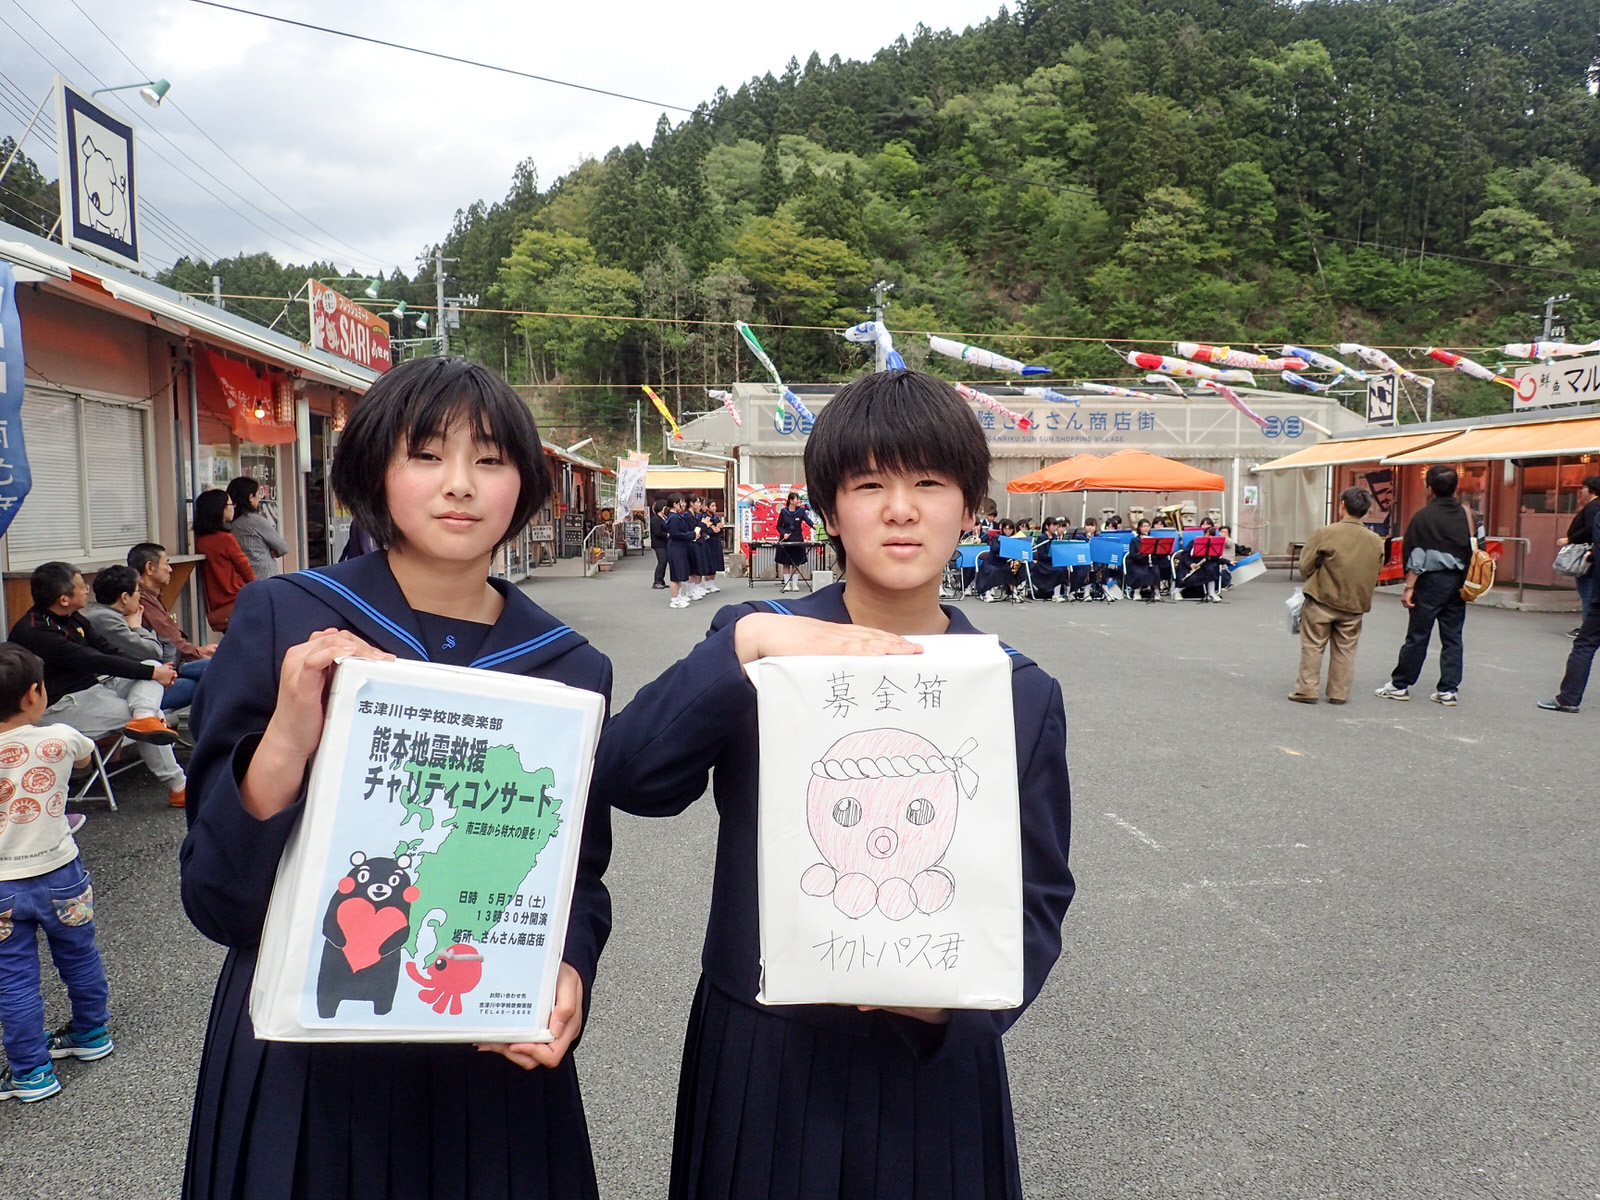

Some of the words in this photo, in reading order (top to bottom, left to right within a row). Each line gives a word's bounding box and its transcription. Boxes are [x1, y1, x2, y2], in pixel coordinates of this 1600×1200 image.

[340, 314, 370, 365] SARI
[1564, 365, 1600, 393] マル
[358, 700, 504, 731] 志津川中学校吹奏楽部
[369, 726, 488, 773] 熊本地震救援
[363, 765, 552, 817] チャリティコンサート
[459, 891, 479, 904] 日時
[477, 910, 548, 926] 13時30分開演
[452, 929, 472, 944] 場所
[480, 930, 545, 946] さんさん商店街
[812, 930, 966, 972] オクトパス君
